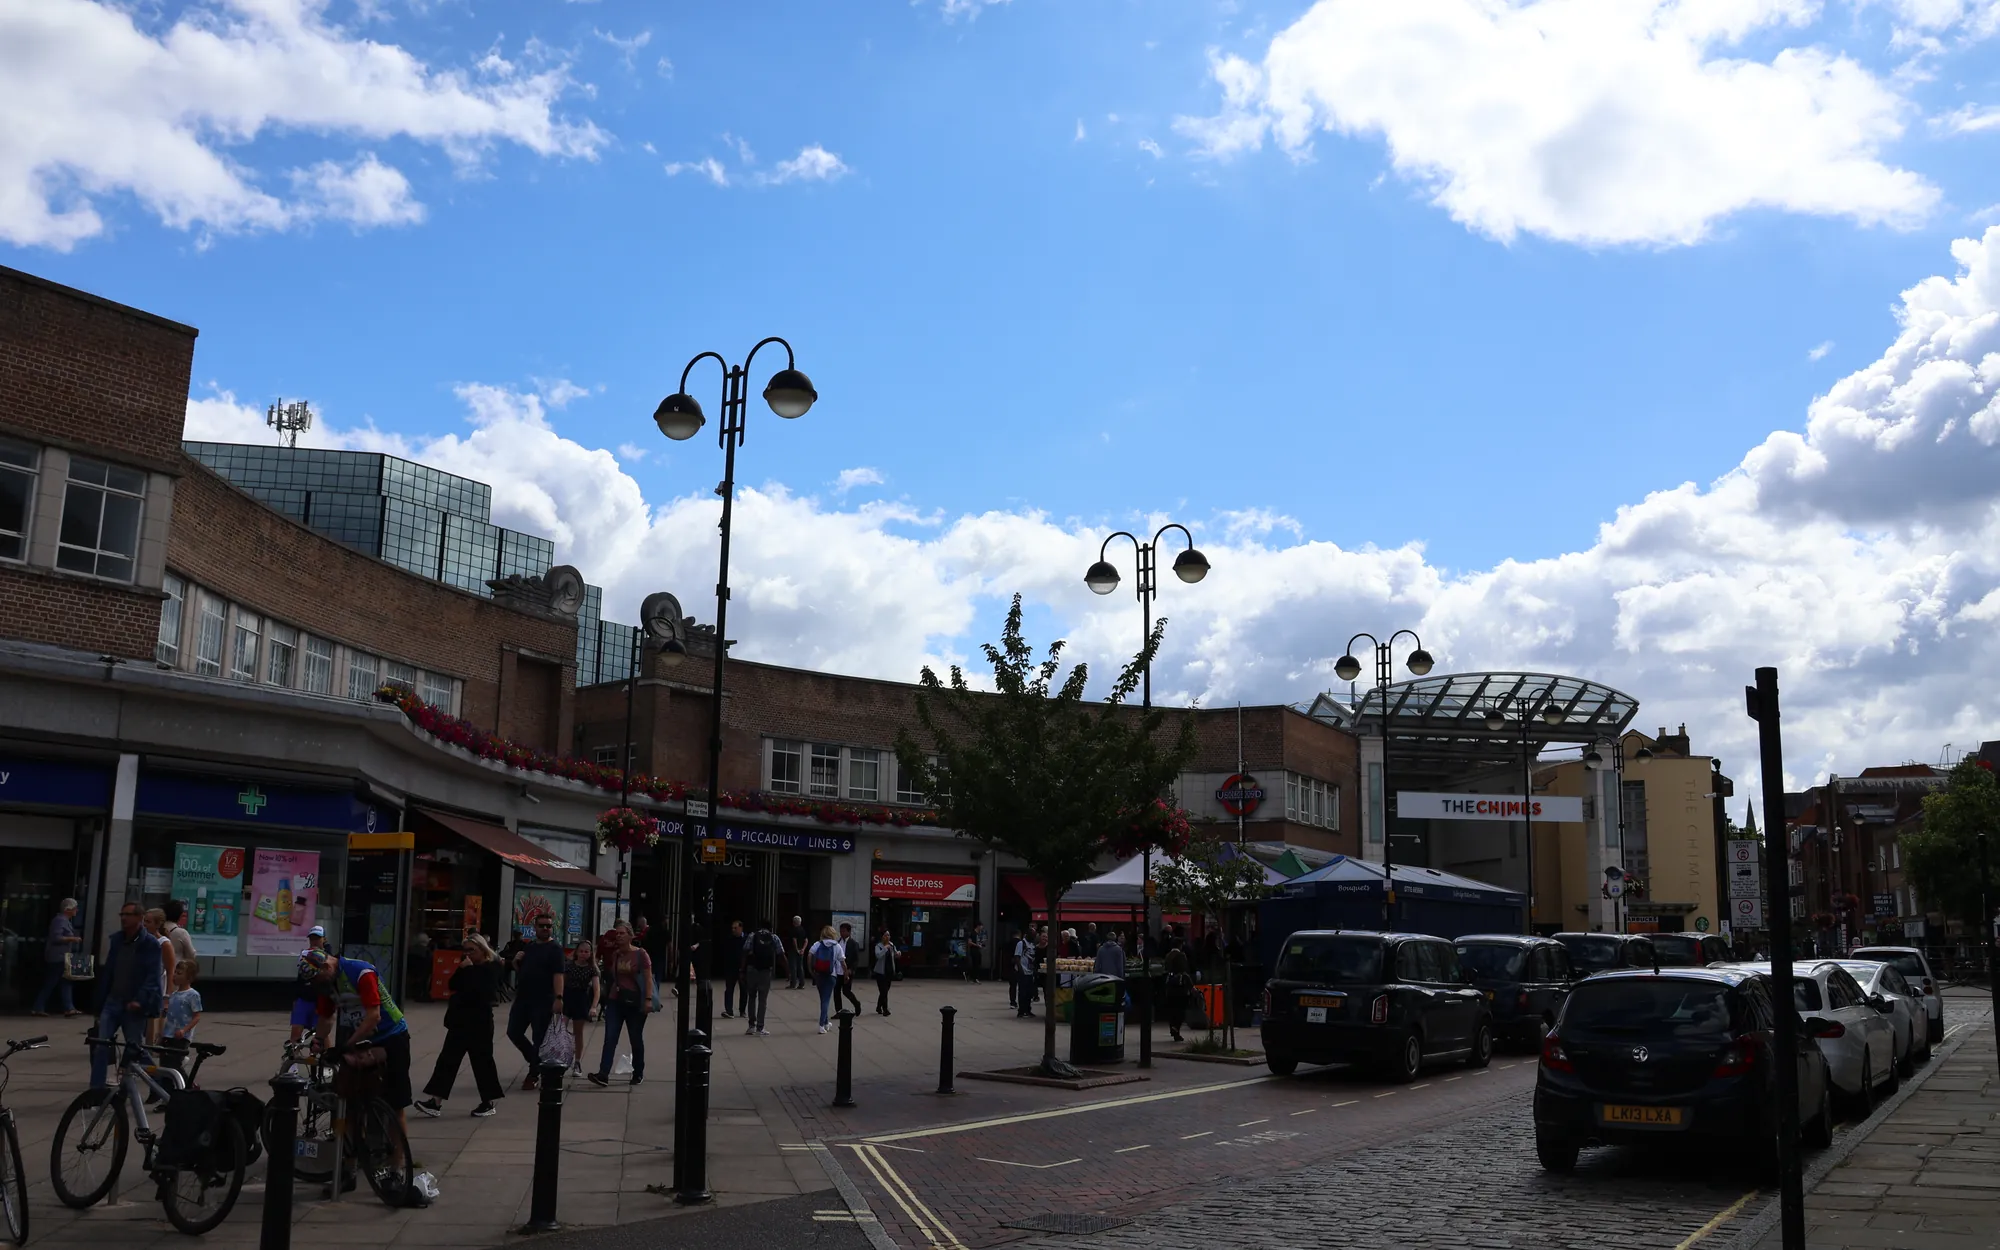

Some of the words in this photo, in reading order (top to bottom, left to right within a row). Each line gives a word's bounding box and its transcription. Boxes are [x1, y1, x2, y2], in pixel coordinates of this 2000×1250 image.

[725, 828, 733, 840] &
[741, 830, 799, 847] PICCADILLY
[808, 837, 837, 850] LINES
[176, 869, 216, 880] summer
[873, 874, 904, 887] Sweet
[906, 876, 944, 889] Express
[1611, 1107, 1642, 1120] LK13
[1645, 1108, 1672, 1122] LXA
